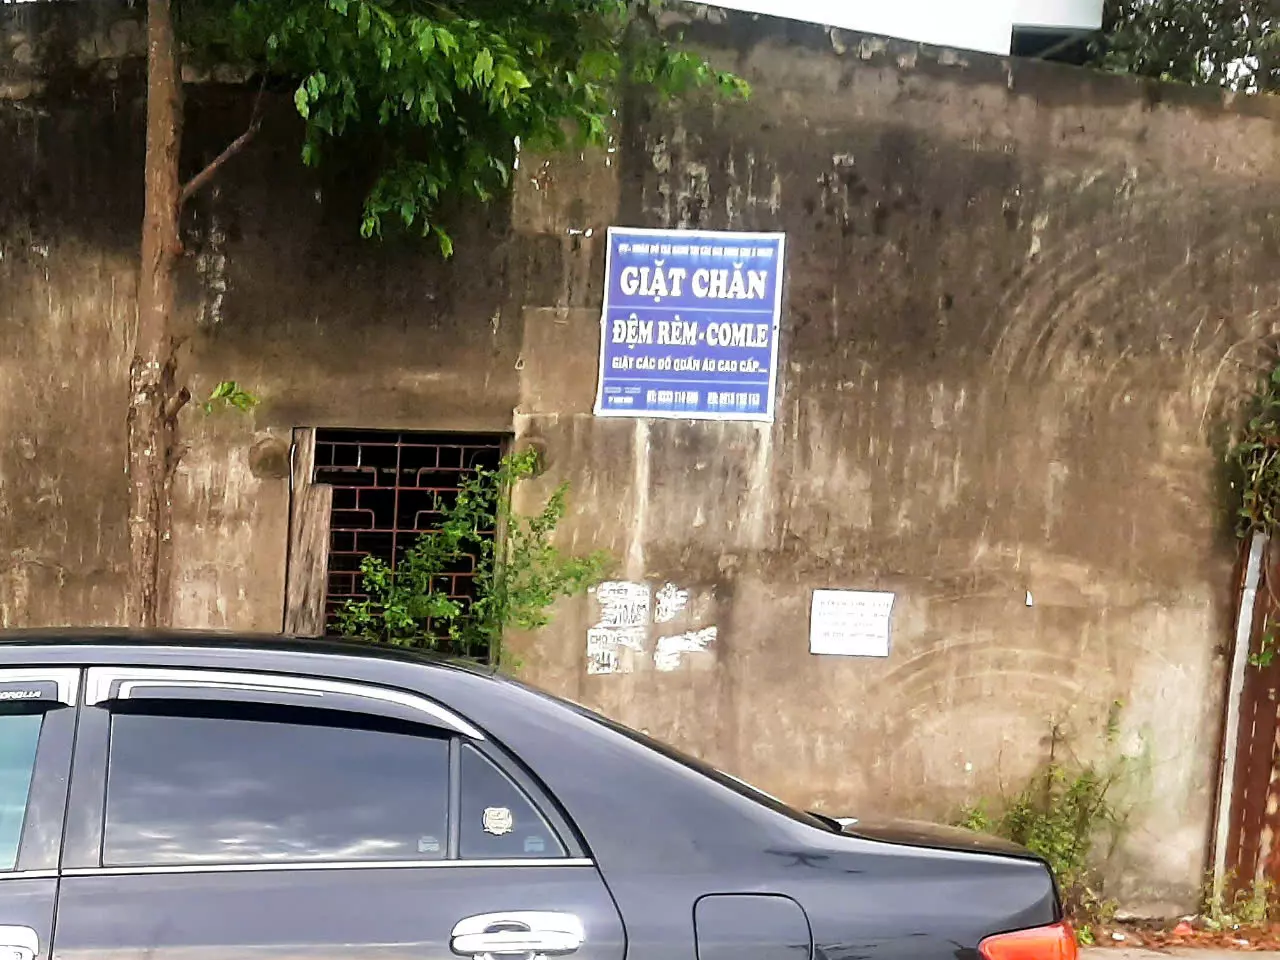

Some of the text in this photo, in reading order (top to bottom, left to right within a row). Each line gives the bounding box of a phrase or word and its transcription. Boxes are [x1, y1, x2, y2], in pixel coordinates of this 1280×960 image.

[620, 259, 768, 302] GIẶT CHĂN
[612, 312, 653, 349] ĐỆM
